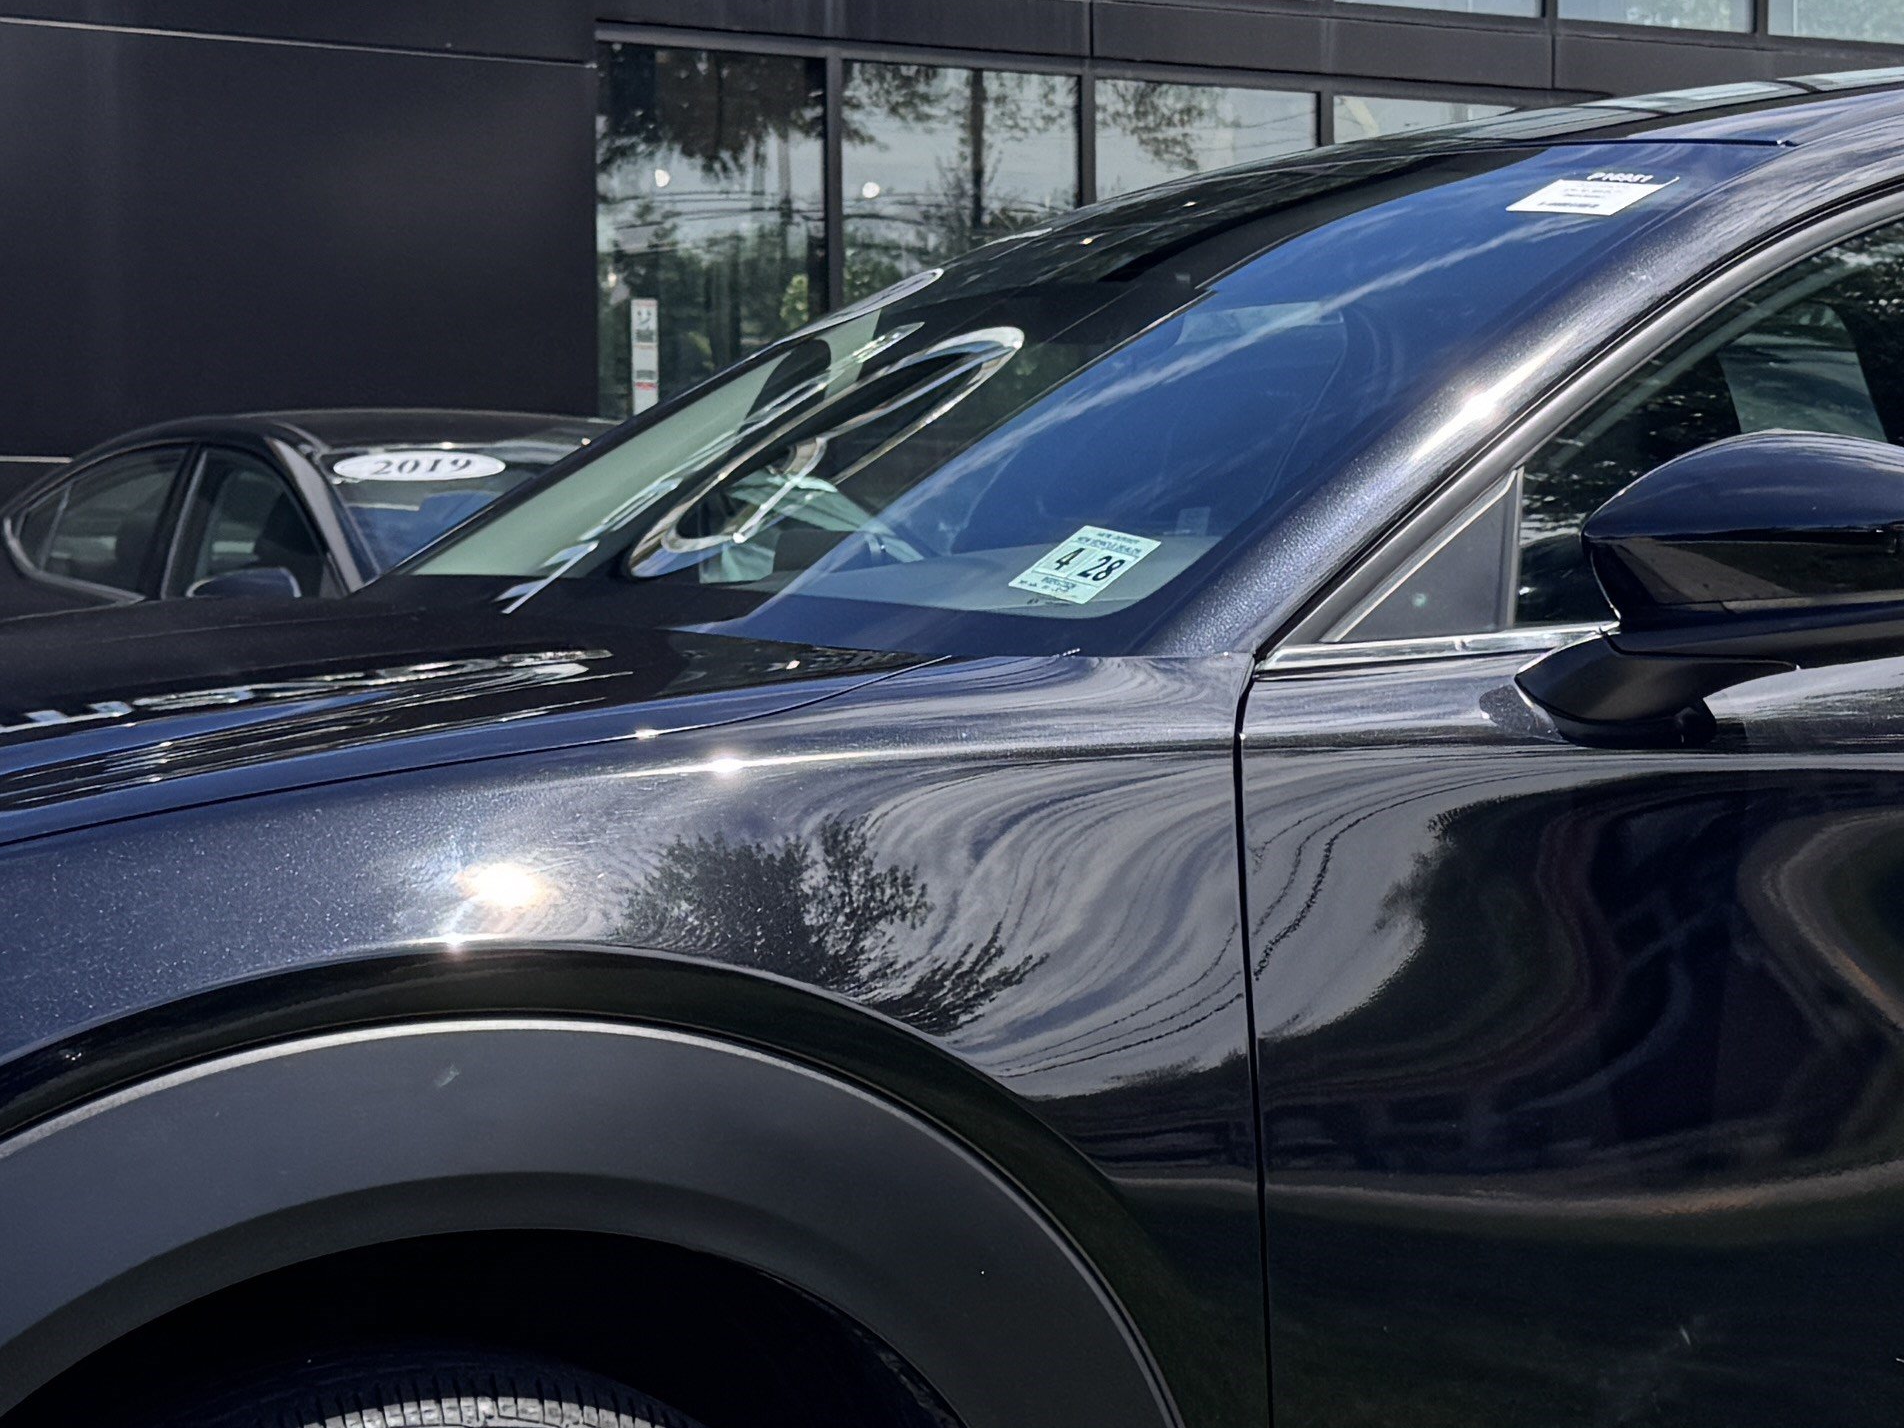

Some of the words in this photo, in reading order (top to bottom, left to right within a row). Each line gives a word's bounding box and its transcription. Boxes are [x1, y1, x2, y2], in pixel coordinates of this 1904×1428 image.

[369, 457, 473, 476] 2019
[1053, 546, 1086, 571] 4
[1076, 554, 1126, 582] 28
